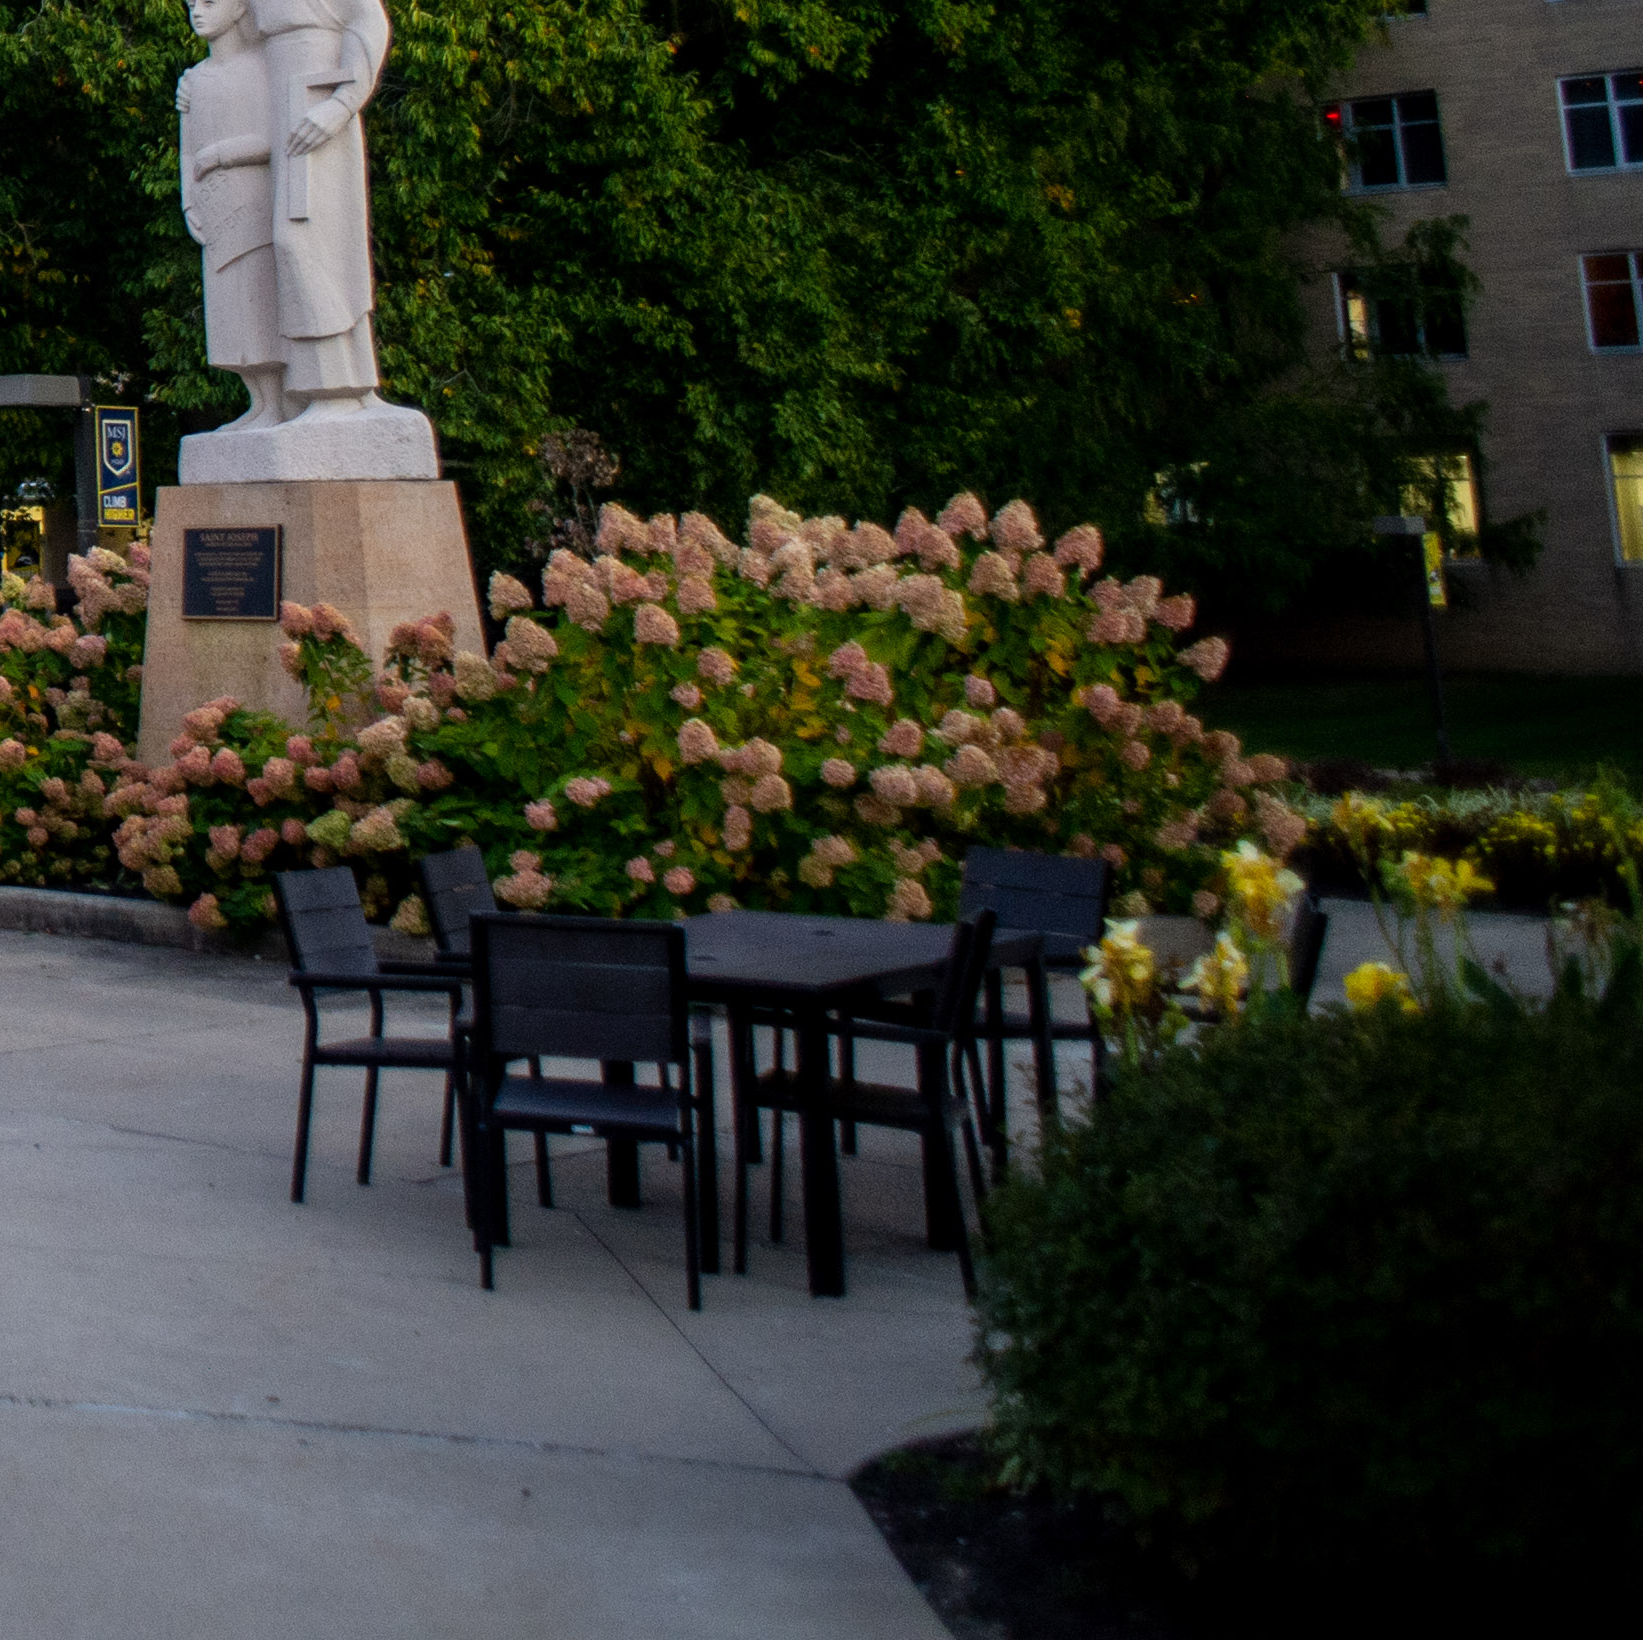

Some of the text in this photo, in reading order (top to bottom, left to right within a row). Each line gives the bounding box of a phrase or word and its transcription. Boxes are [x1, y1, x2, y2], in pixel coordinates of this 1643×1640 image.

[107, 426, 126, 441] MSJ
[103, 495, 127, 508] CLIMB
[199, 532, 260, 541] SAINT JOSEPH
